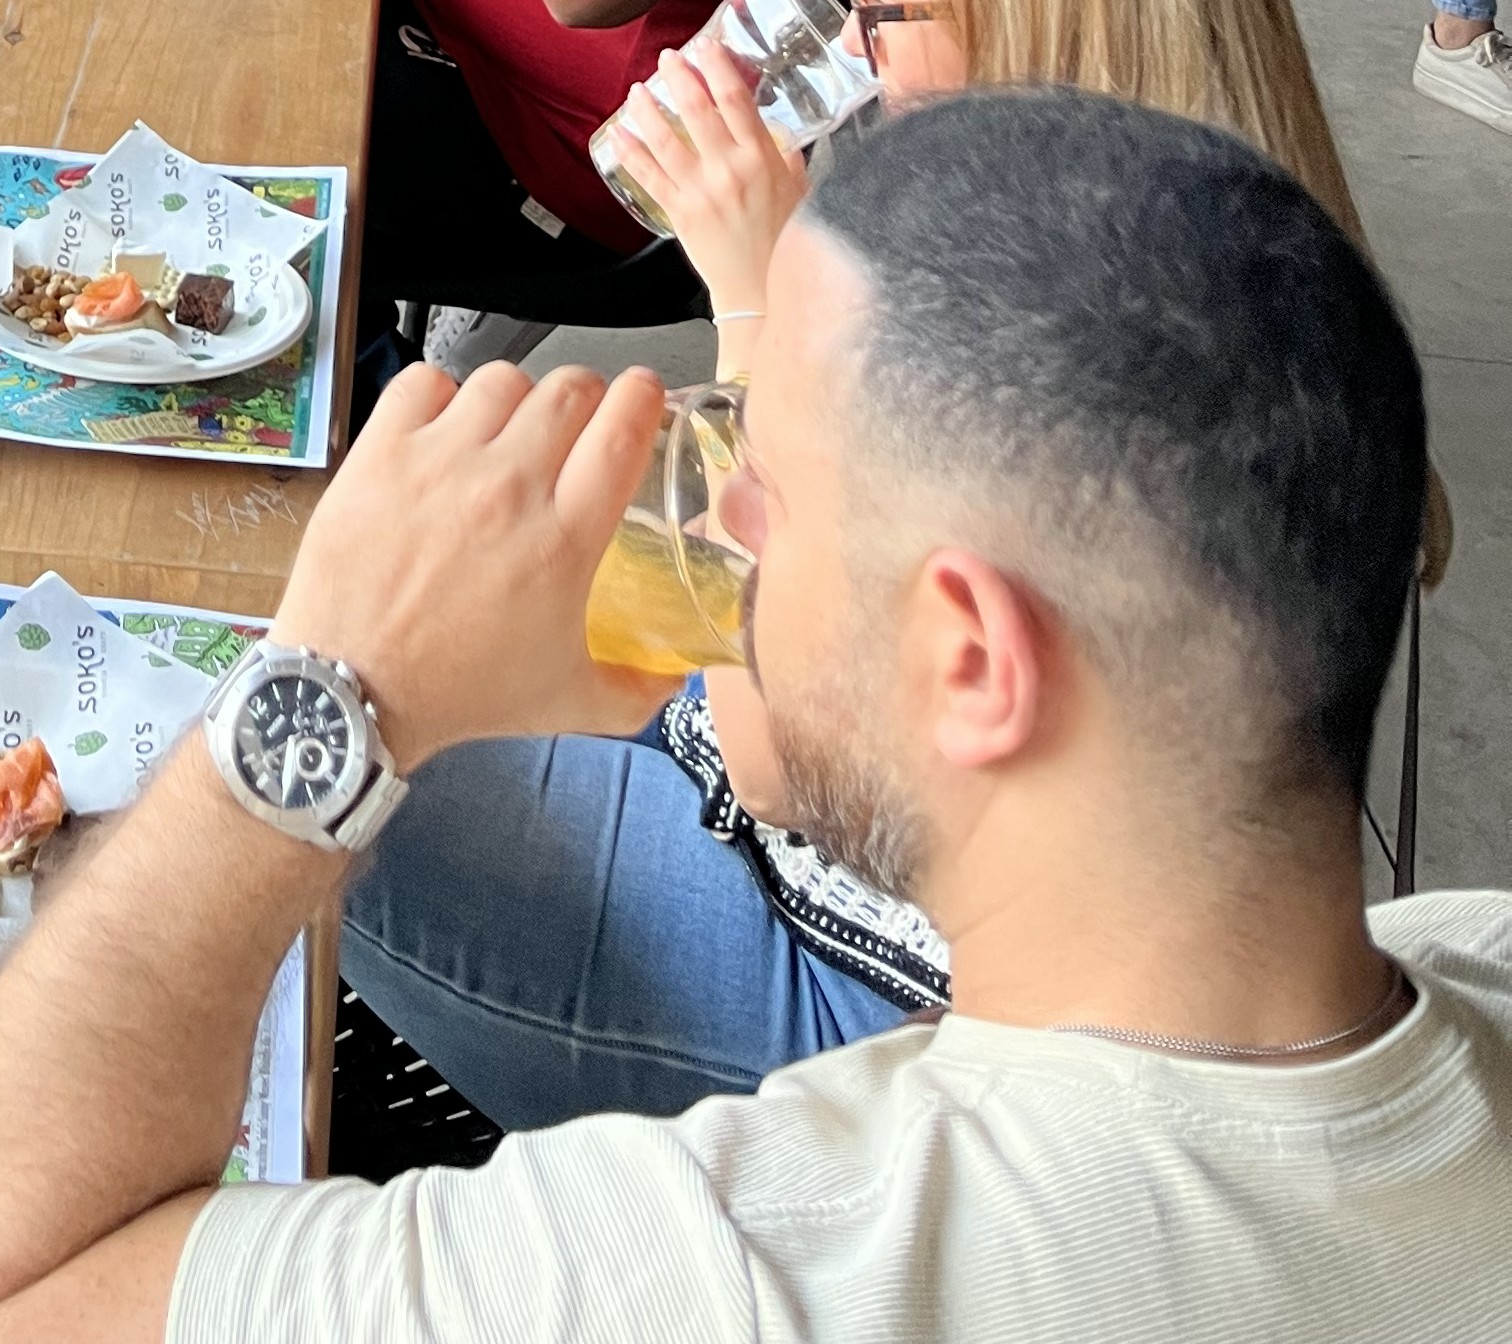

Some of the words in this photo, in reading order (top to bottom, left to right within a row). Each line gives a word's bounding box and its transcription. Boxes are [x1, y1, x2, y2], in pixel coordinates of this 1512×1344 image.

[107, 172, 131, 238] SOKO'S
[204, 188, 228, 252] SOKO'S
[56, 208, 82, 273] OKO'S
[72, 624, 105, 714] SOKO'S
